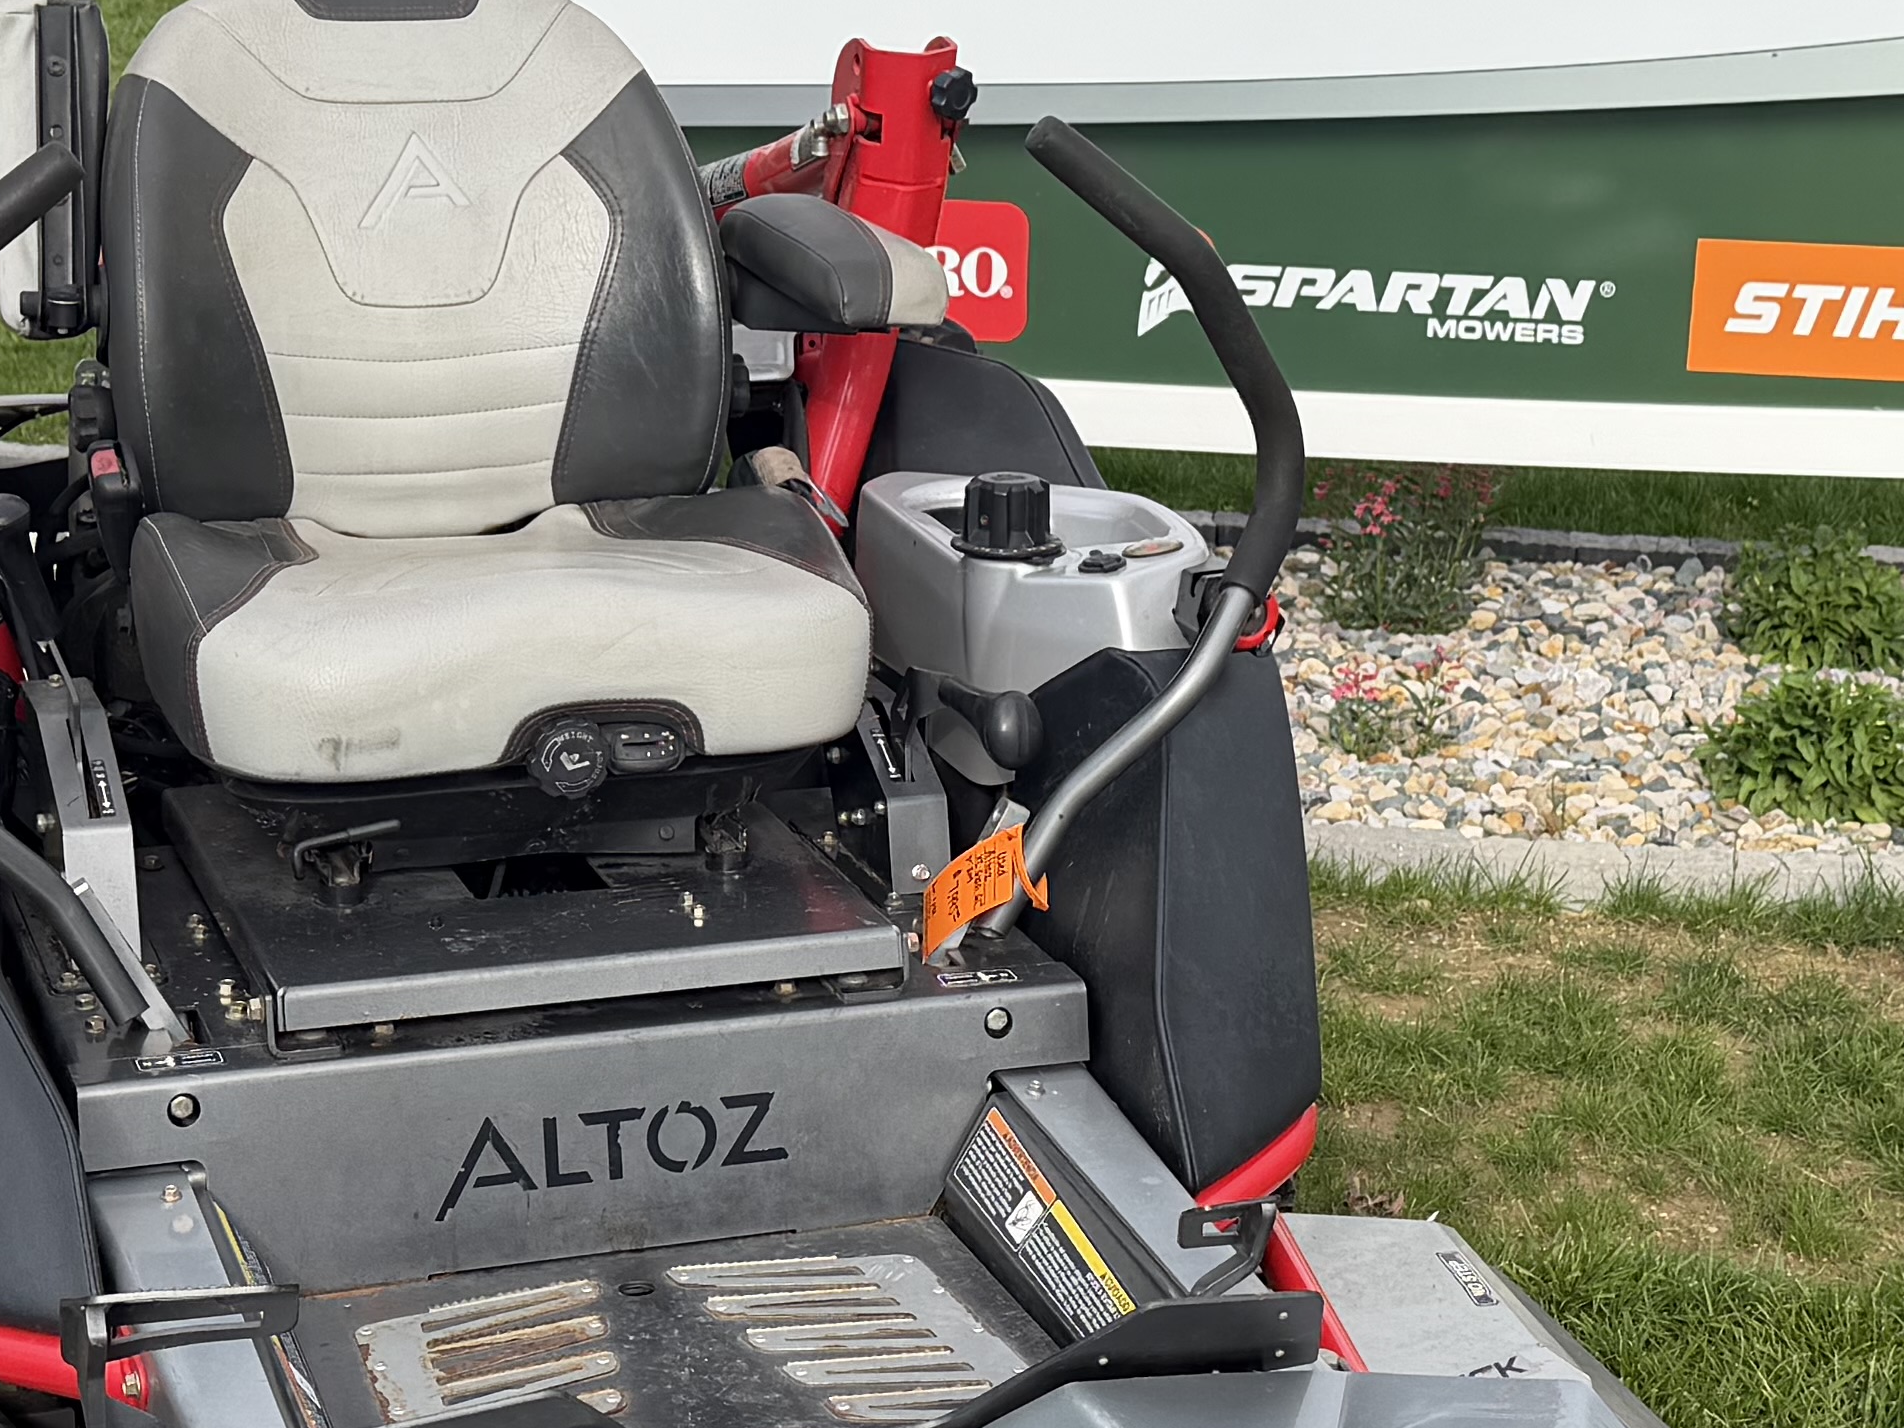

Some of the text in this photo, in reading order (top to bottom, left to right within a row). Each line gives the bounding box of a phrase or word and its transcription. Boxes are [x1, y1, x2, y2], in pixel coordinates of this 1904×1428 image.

[1238, 264, 1596, 321] SPARTAN
[1427, 317, 1584, 345] MOWERS
[435, 1091, 788, 1222] ALTOZ
